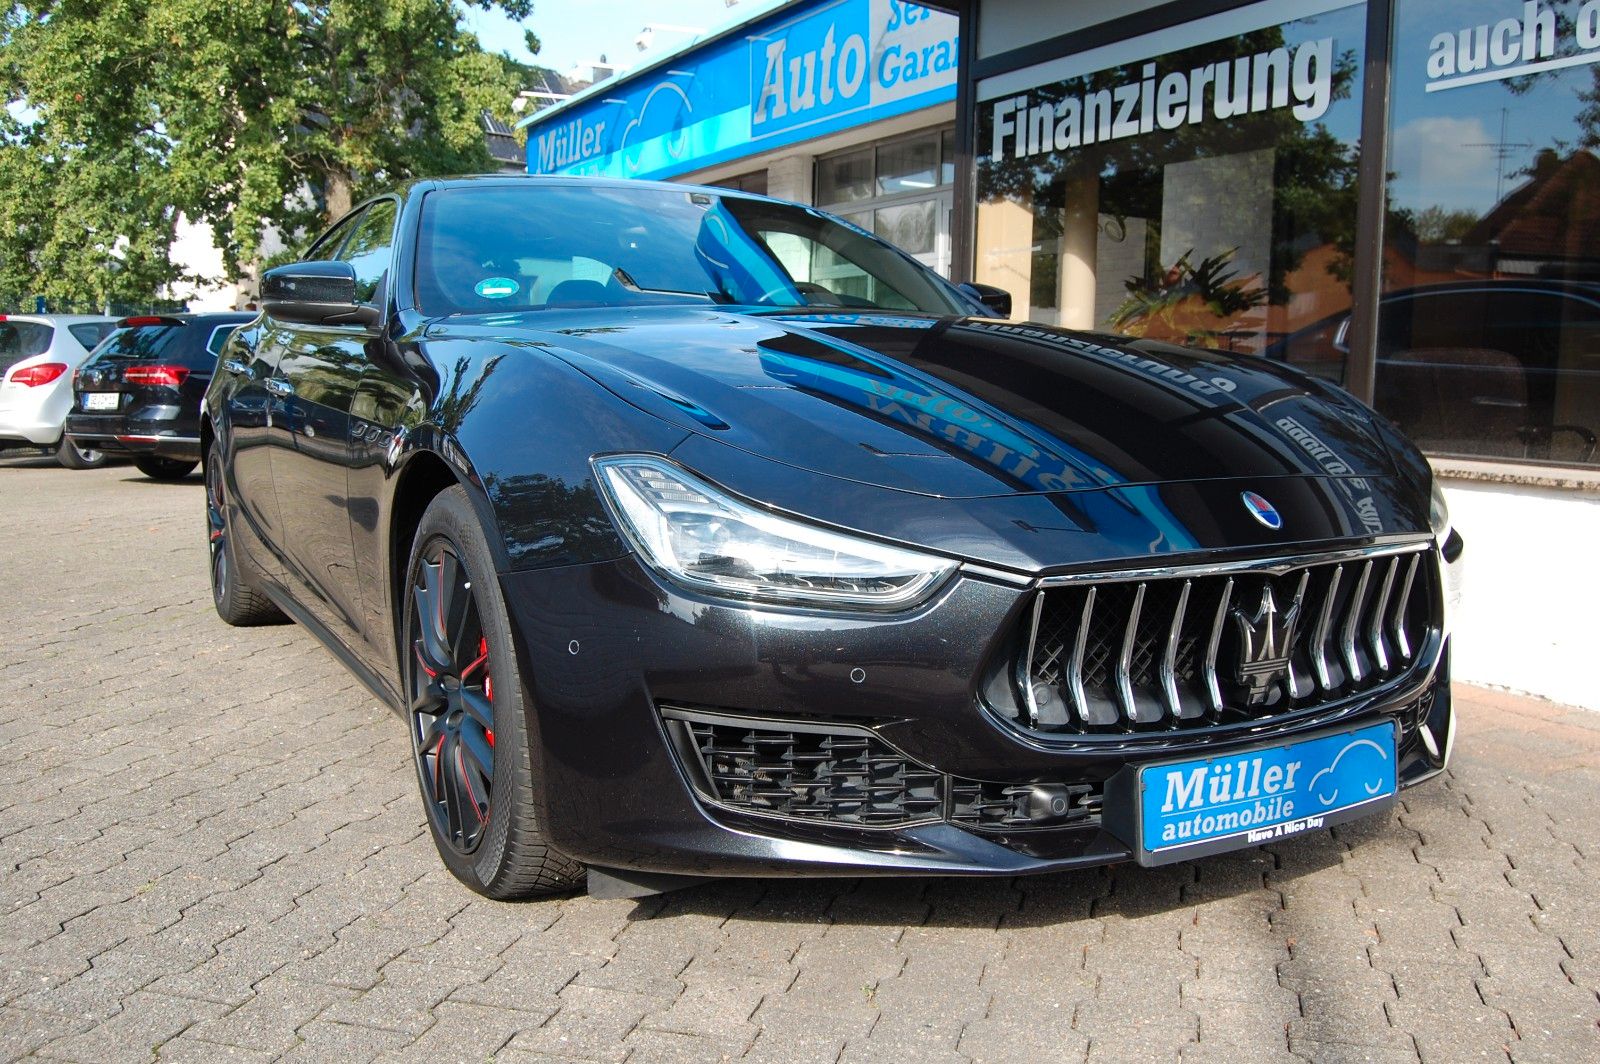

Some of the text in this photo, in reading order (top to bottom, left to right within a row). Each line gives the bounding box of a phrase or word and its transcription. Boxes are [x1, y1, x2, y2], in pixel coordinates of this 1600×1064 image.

[1426, 0, 1556, 79] auch
[753, 22, 866, 125] Auto
[991, 36, 1334, 163] Finanzierung
[536, 118, 606, 175] Müller
[1161, 757, 1302, 813] Müller
[1162, 796, 1295, 842] automobile
[1247, 816, 1325, 843] Have A Nice Day
